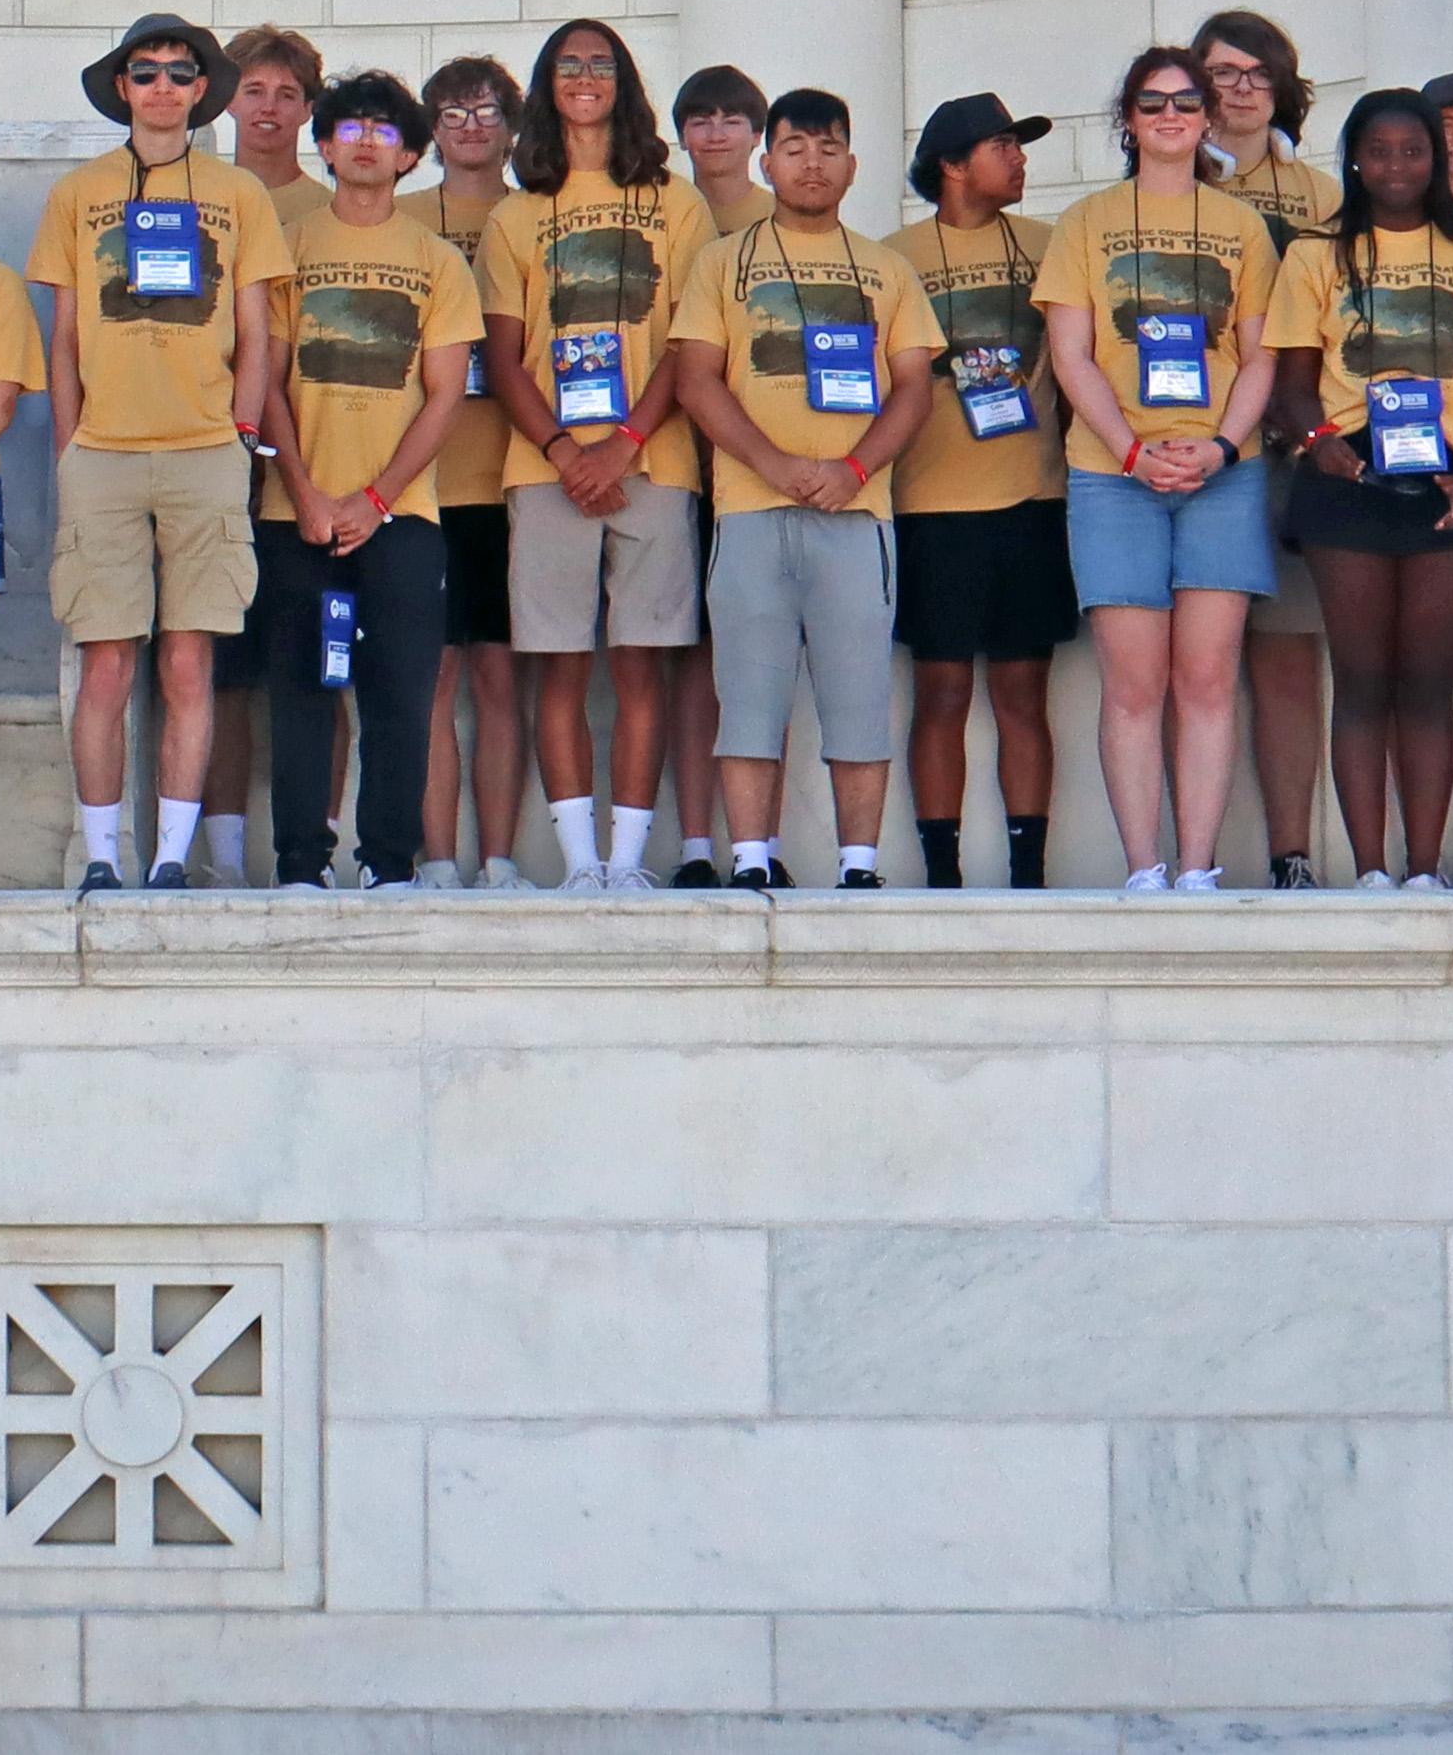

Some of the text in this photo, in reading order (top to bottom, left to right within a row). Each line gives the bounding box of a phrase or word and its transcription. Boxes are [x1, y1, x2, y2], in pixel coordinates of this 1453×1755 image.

[89, 196, 230, 214] ELECT COOPEATIVE
[1250, 198, 1308, 218] TOUR
[87, 211, 127, 231] YOU
[199, 212, 231, 232] UR
[537, 212, 666, 243] YOUTH TOUR
[1100, 237, 1242, 260] YOUTH TOUR
[297, 262, 432, 279] ELECTRIC COOPERATIVE
[750, 269, 883, 290] OUTH TOUR
[924, 268, 1036, 293] OUTH TOU
[294, 270, 433, 299] YOUTH TOUR
[1335, 272, 1410, 292] YUTH
